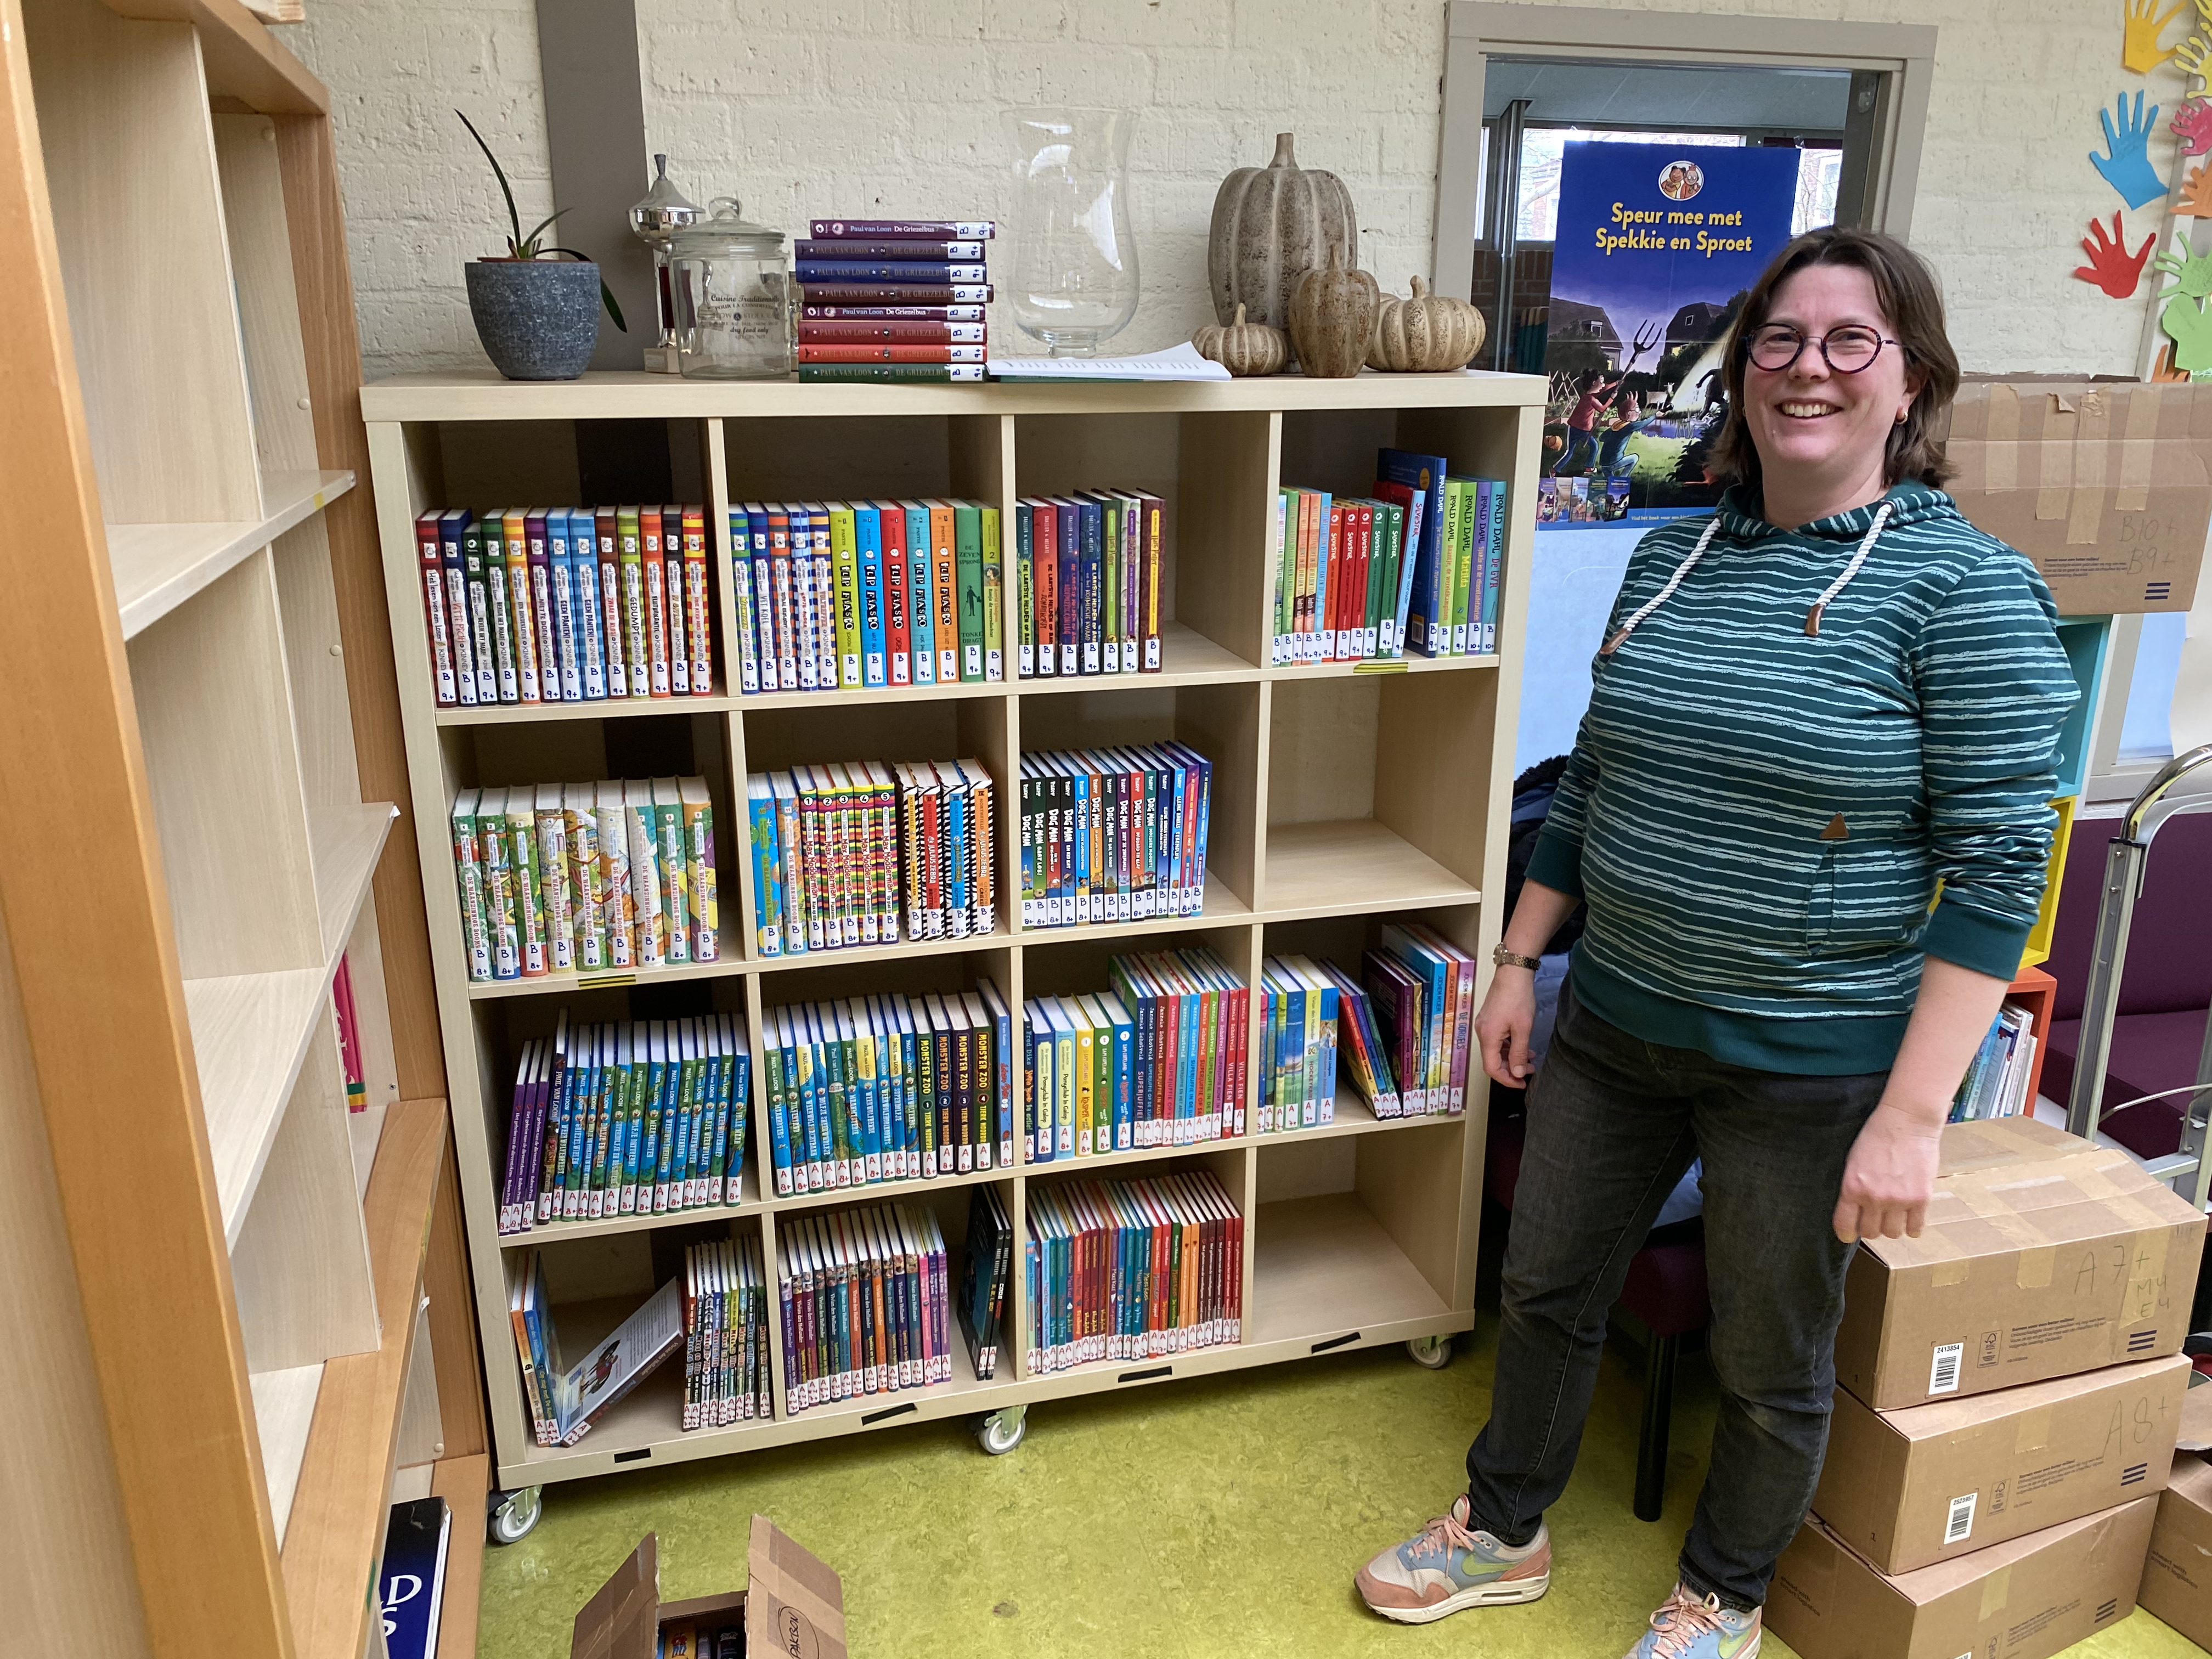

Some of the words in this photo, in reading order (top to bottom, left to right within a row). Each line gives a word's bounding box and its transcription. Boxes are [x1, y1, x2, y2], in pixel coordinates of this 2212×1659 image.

[1611, 202, 1663, 230] Speur
[1668, 212, 1705, 226] mee
[1708, 210, 1742, 227] met
[1595, 228, 1665, 255] Spekkie
[1671, 236, 1691, 250] en
[1696, 230, 1752, 258] Sproet
[1464, 495, 1472, 523] ROALD
[1494, 494, 1504, 524] ROALD
[1390, 531, 1398, 559] SILVESTER
[1462, 527, 1472, 551] DAHL
[1492, 528, 1502, 554] DAHL
[1460, 555, 1470, 588] Matilda
[1491, 557, 1500, 568] De
[1489, 570, 1499, 589] GVR
[430, 585, 438, 600] leven
[630, 597, 639, 635] GEDUMPT
[1106, 806, 1115, 820] DOG
[1147, 798, 1155, 810] DOG
[1022, 815, 1031, 831] DOG
[1035, 813, 1043, 828] DOG
[1064, 809, 1073, 825] DOG
[1147, 812, 1155, 826] MAN
[1035, 830, 1044, 844] MAN
[1064, 827, 1073, 842] MAN
[1106, 821, 1115, 836] MAN
[979, 838, 987, 858] JULIUS
[1022, 832, 1031, 847] MAN
[808, 856, 819, 898] Modderman
[827, 857, 837, 899] Modderman
[884, 852, 893, 893] Modderman
[978, 1034, 988, 1070] MONSTER
[978, 1072, 988, 1088] ZOO
[2074, 1251, 2097, 1295] A
[1953, 1496, 1974, 1505] 2523957
[789, 1611, 802, 1658] PAKBON
